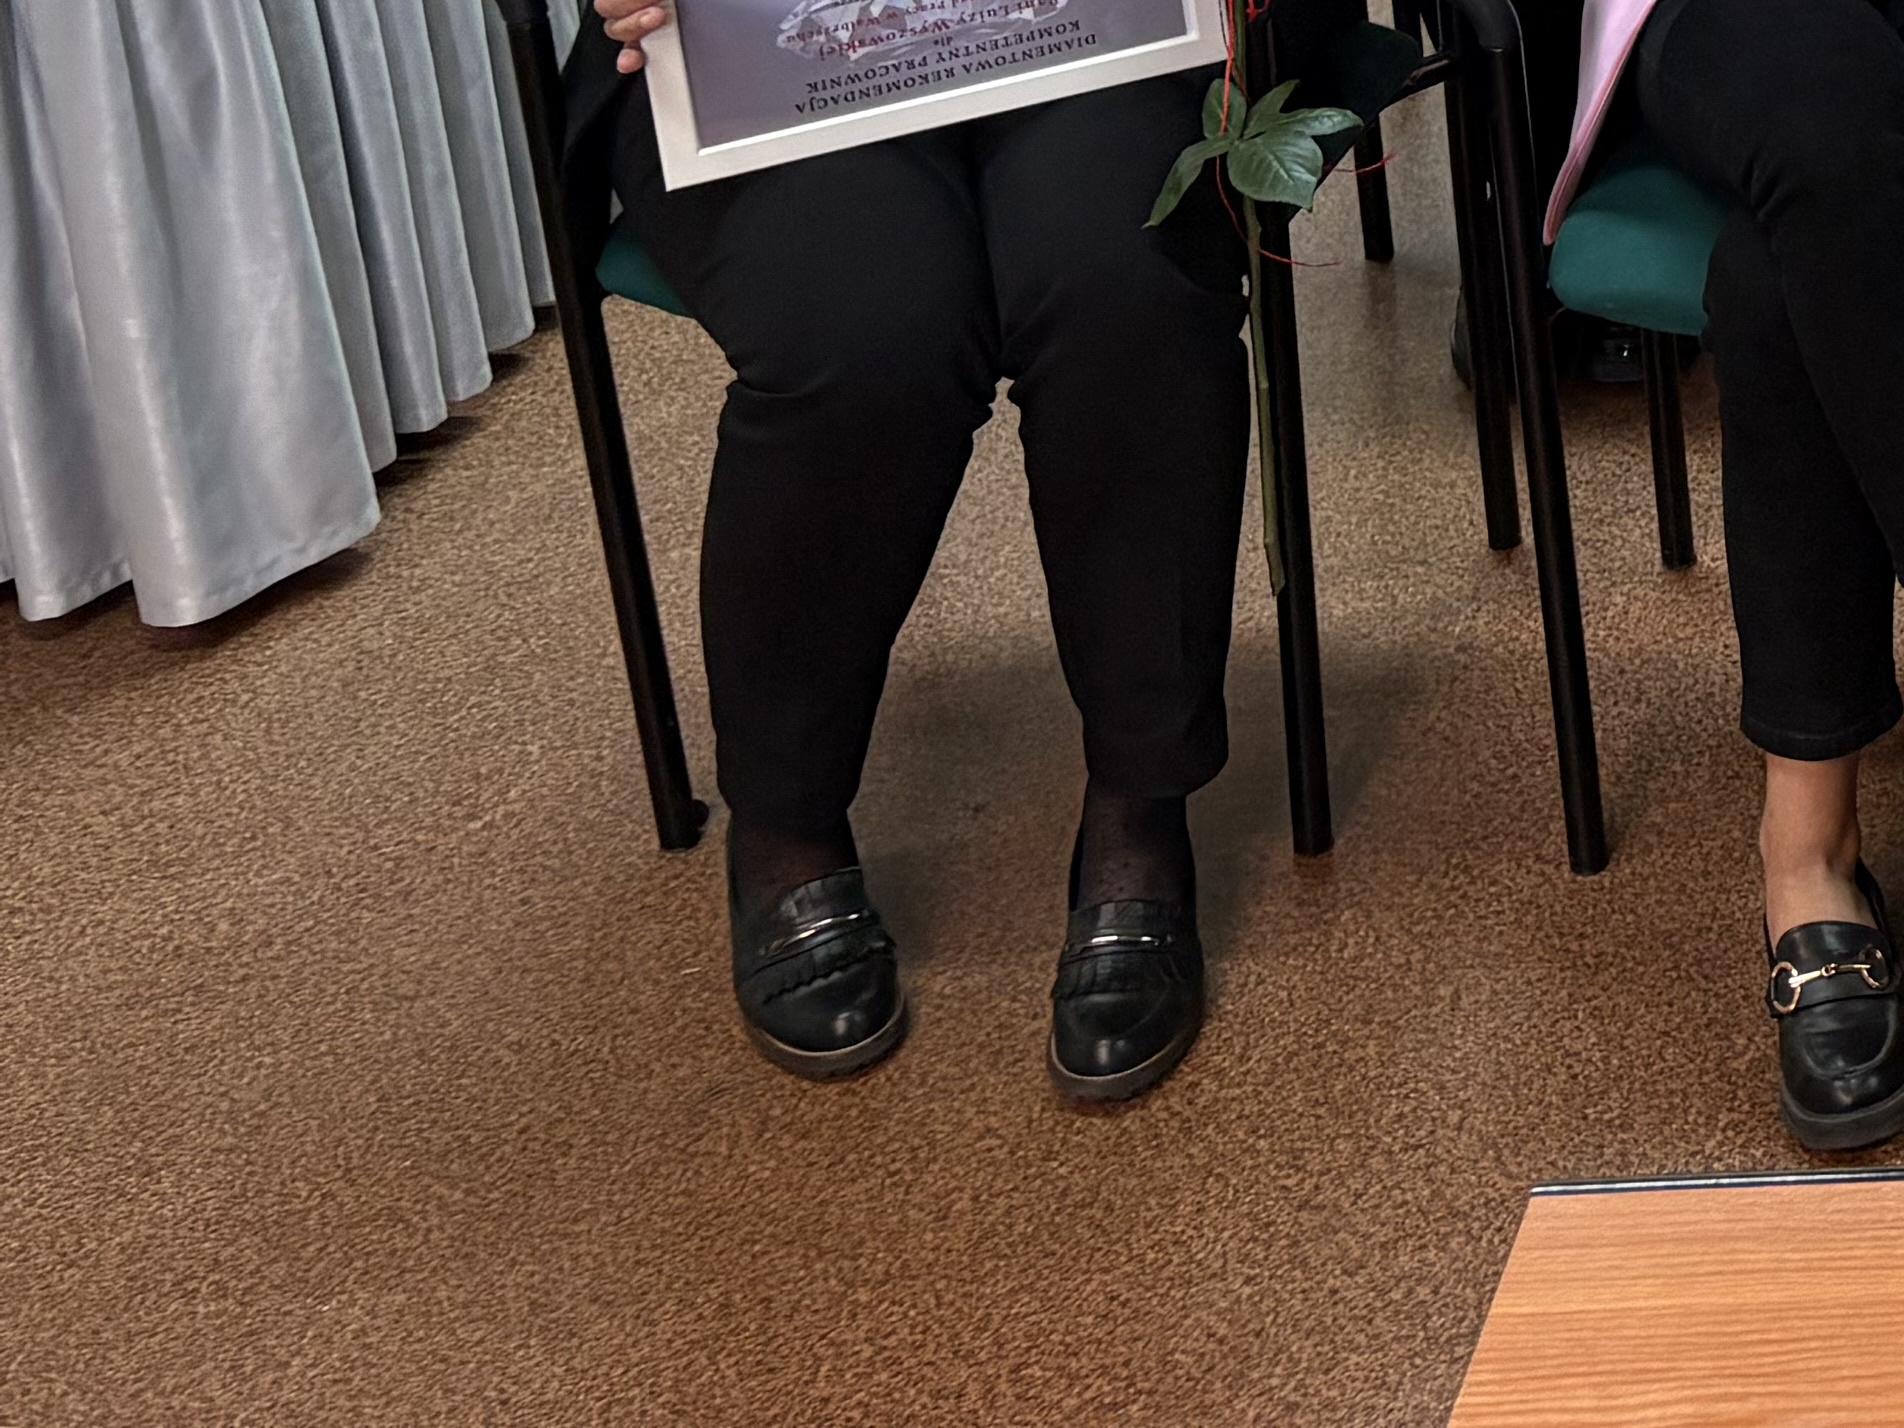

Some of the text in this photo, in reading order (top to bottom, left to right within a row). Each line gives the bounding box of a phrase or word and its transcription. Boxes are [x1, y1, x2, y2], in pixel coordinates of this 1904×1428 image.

[793, 32, 1097, 115] DIAMENTOWA REKOMENDACJA
[804, 18, 1080, 94] KOMPETENTNY PRACOWNIK
